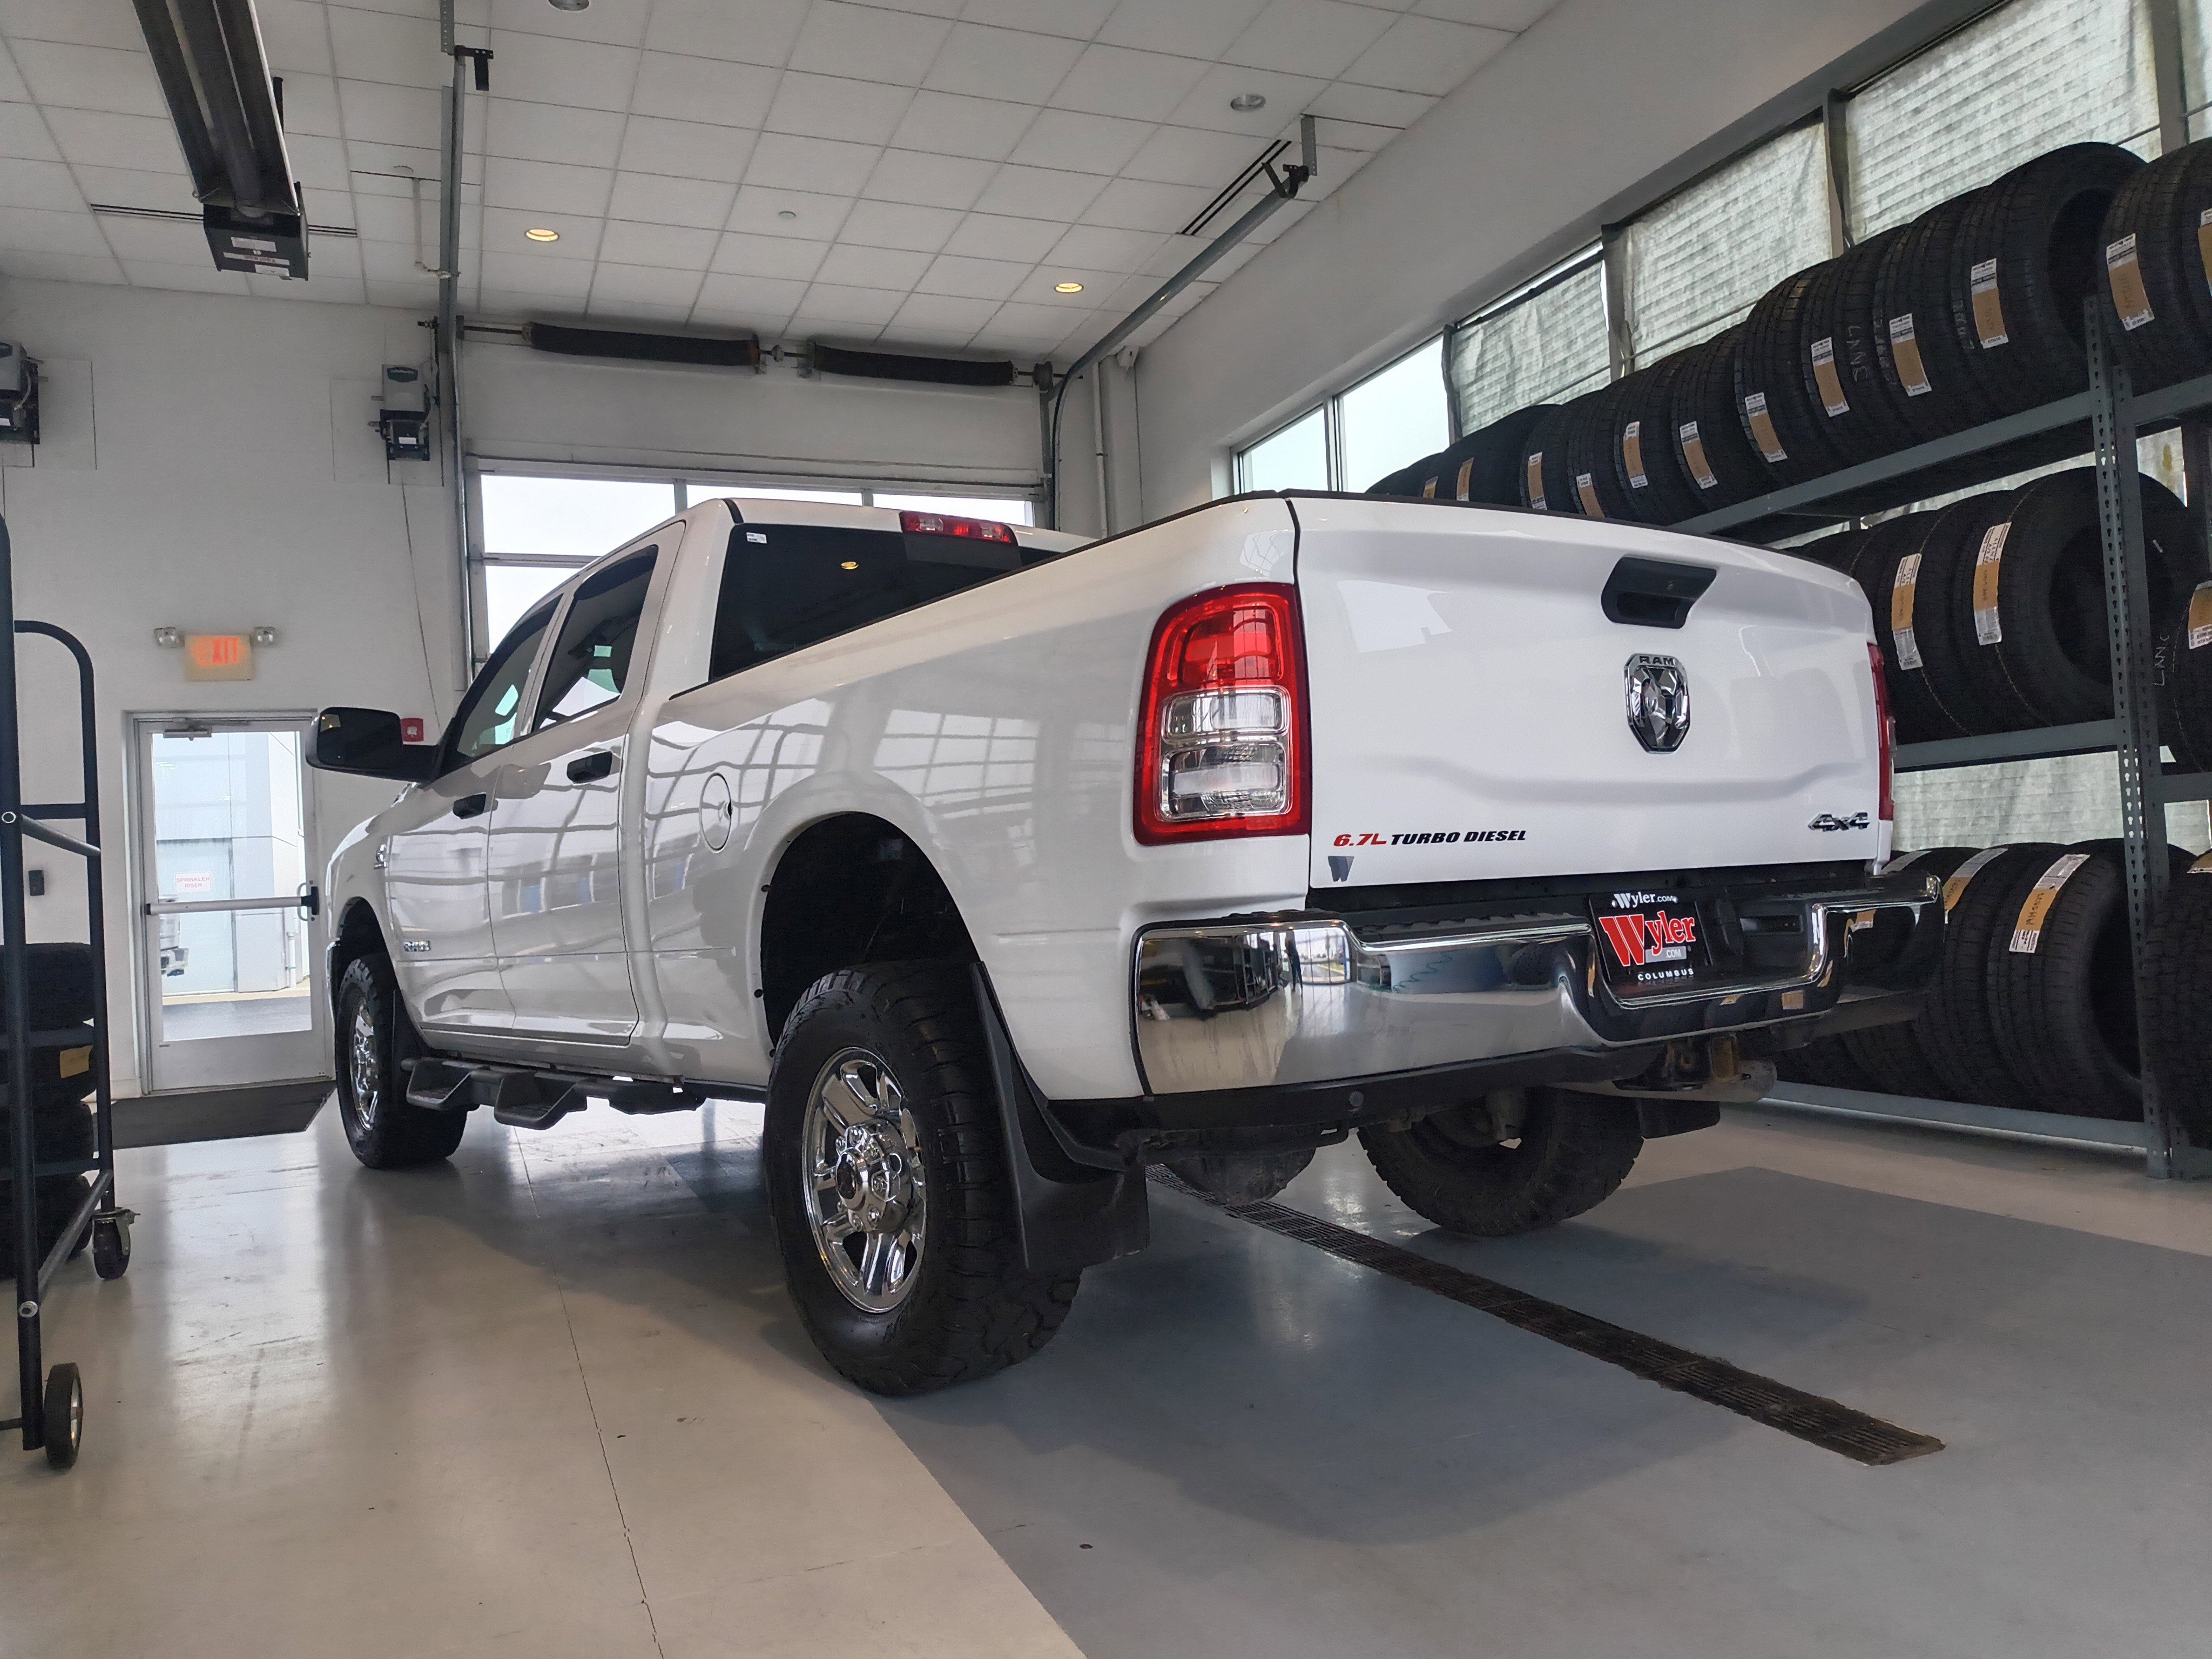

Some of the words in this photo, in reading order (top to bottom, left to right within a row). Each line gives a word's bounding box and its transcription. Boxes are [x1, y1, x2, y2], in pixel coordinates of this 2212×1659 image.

[1639, 656, 1675, 666] RAM
[1333, 833, 1387, 847] 6.7L
[1391, 832, 1460, 845] TURBO
[1463, 830, 1526, 842] DIESEL
[1599, 910, 1696, 967] Wyler
[1637, 968, 1694, 981] COLUMBUS
